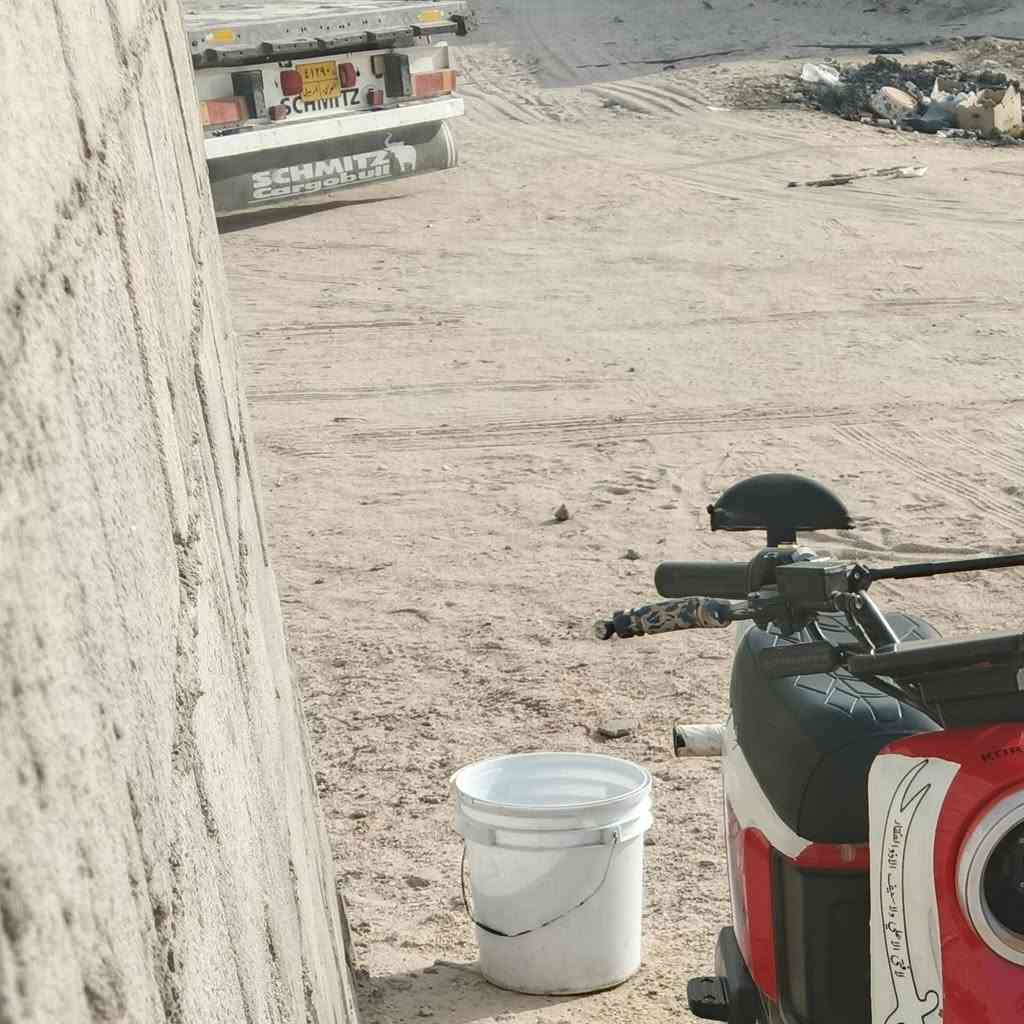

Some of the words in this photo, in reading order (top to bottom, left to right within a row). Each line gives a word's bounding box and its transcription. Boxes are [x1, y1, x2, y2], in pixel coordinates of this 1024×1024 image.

[280, 87, 361, 115] SCHMITZ
[252, 149, 390, 188] SCHMITZ
[252, 159, 390, 199] cargobull
